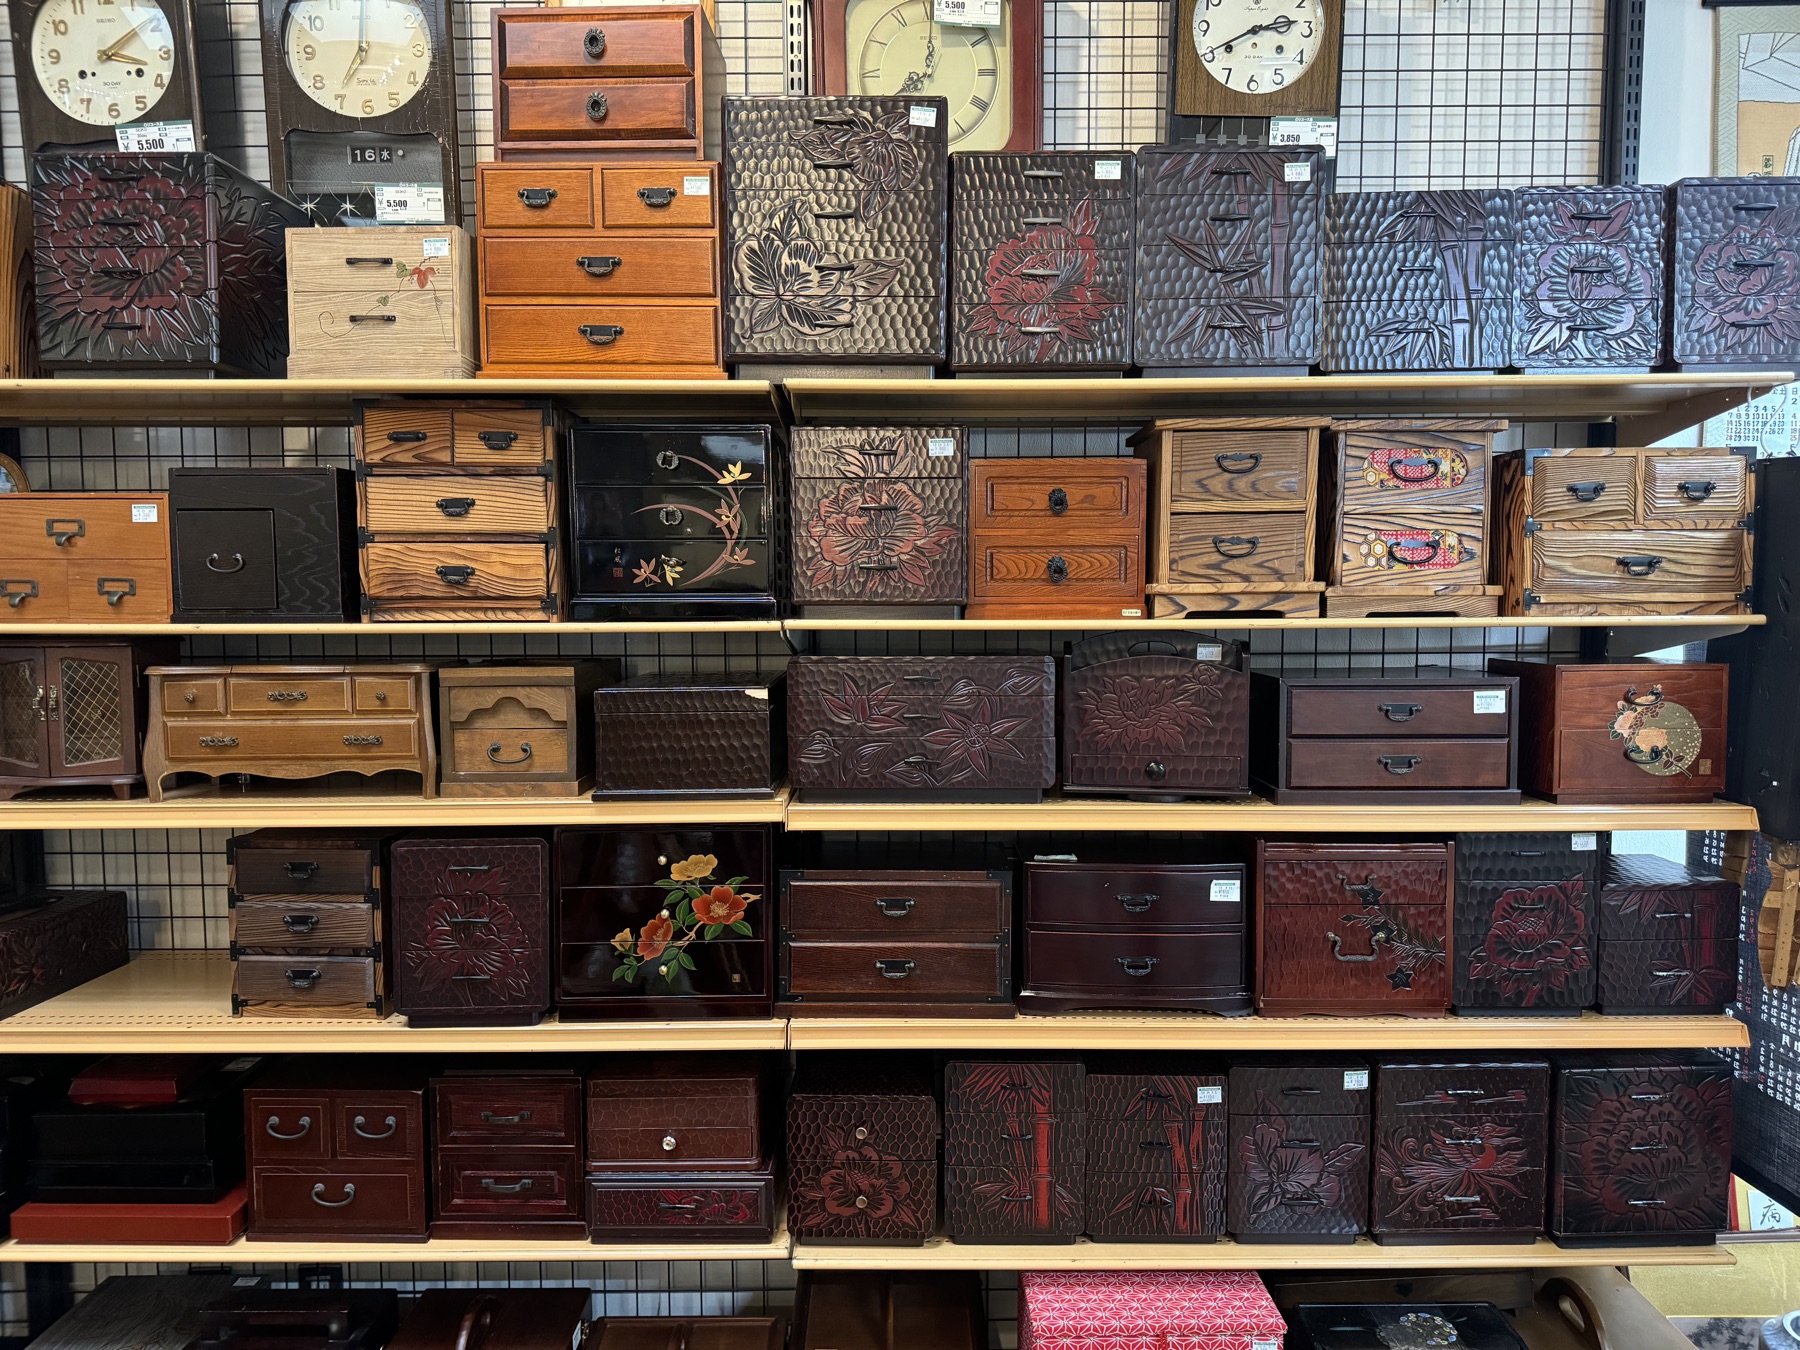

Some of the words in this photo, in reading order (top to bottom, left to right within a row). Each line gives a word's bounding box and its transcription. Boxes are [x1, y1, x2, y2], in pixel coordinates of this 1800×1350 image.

[945, 1, 966, 9] 5,500
[52, 19, 68, 36] 10
[150, 18, 163, 32] 2
[308, 14, 325, 32] 10
[404, 12, 416, 29] 2
[1198, 20, 1210, 37] 9
[1300, 20, 1313, 38] 3
[48, 48, 61, 65] 9
[158, 45, 171, 61] 3
[304, 44, 316, 61] 9
[412, 44, 425, 58] 3
[1204, 46, 1216, 63] 8
[1292, 48, 1304, 65] 4
[154, 73, 165, 90] 4
[312, 74, 326, 90] 8
[407, 70, 419, 87] 4
[1222, 68, 1233, 85] 7
[1246, 74, 1259, 91] 6
[1272, 68, 1285, 86] 5
[58, 78, 71, 94] 8
[80, 98, 92, 114] 7
[135, 96, 147, 111] 5
[334, 94, 347, 110] 7
[362, 99, 375, 115] 6
[388, 92, 400, 108] 5
[108, 102, 121, 119] 6
[122, 142, 130, 152] ¥
[137, 138, 165, 151] 5,500
[1272, 133, 1278, 142] ¥
[1280, 134, 1301, 143] 3,850
[354, 149, 375, 161] 16
[381, 149, 390, 160] 水
[378, 198, 384, 206] ¥
[386, 200, 408, 208] 5,500
